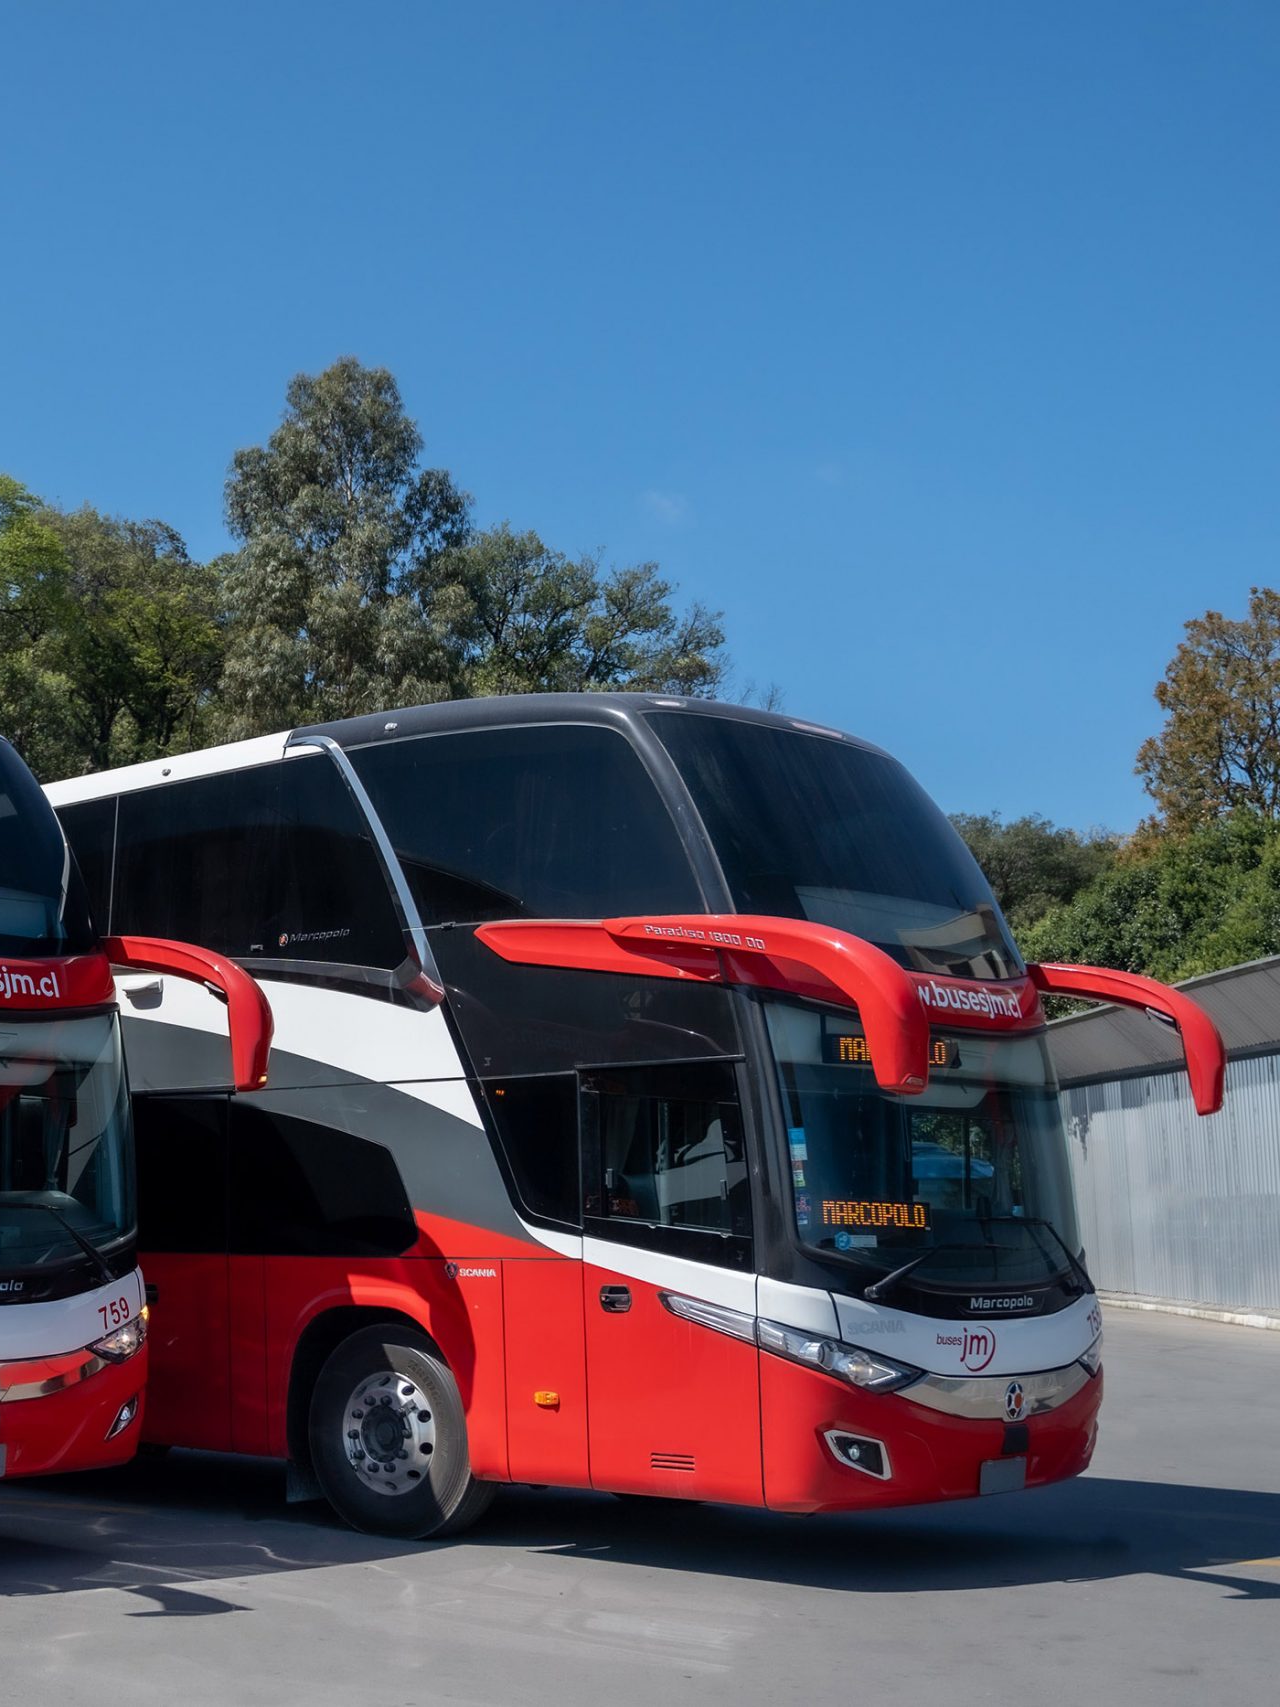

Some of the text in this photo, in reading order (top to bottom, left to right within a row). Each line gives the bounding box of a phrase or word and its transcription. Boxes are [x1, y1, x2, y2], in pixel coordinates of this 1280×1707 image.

[289, 928, 351, 943] Marcopolo
[644, 924, 706, 940] Paradiso
[708, 931, 742, 946] 1800
[822, 1200, 926, 1228] MARCOPOLO
[459, 1267, 496, 1277] SCANIA
[970, 1295, 1034, 1310] Marcopolo
[97, 1296, 130, 1331] 759
[847, 1319, 907, 1336] SCANIA
[936, 1333, 963, 1346] buses
